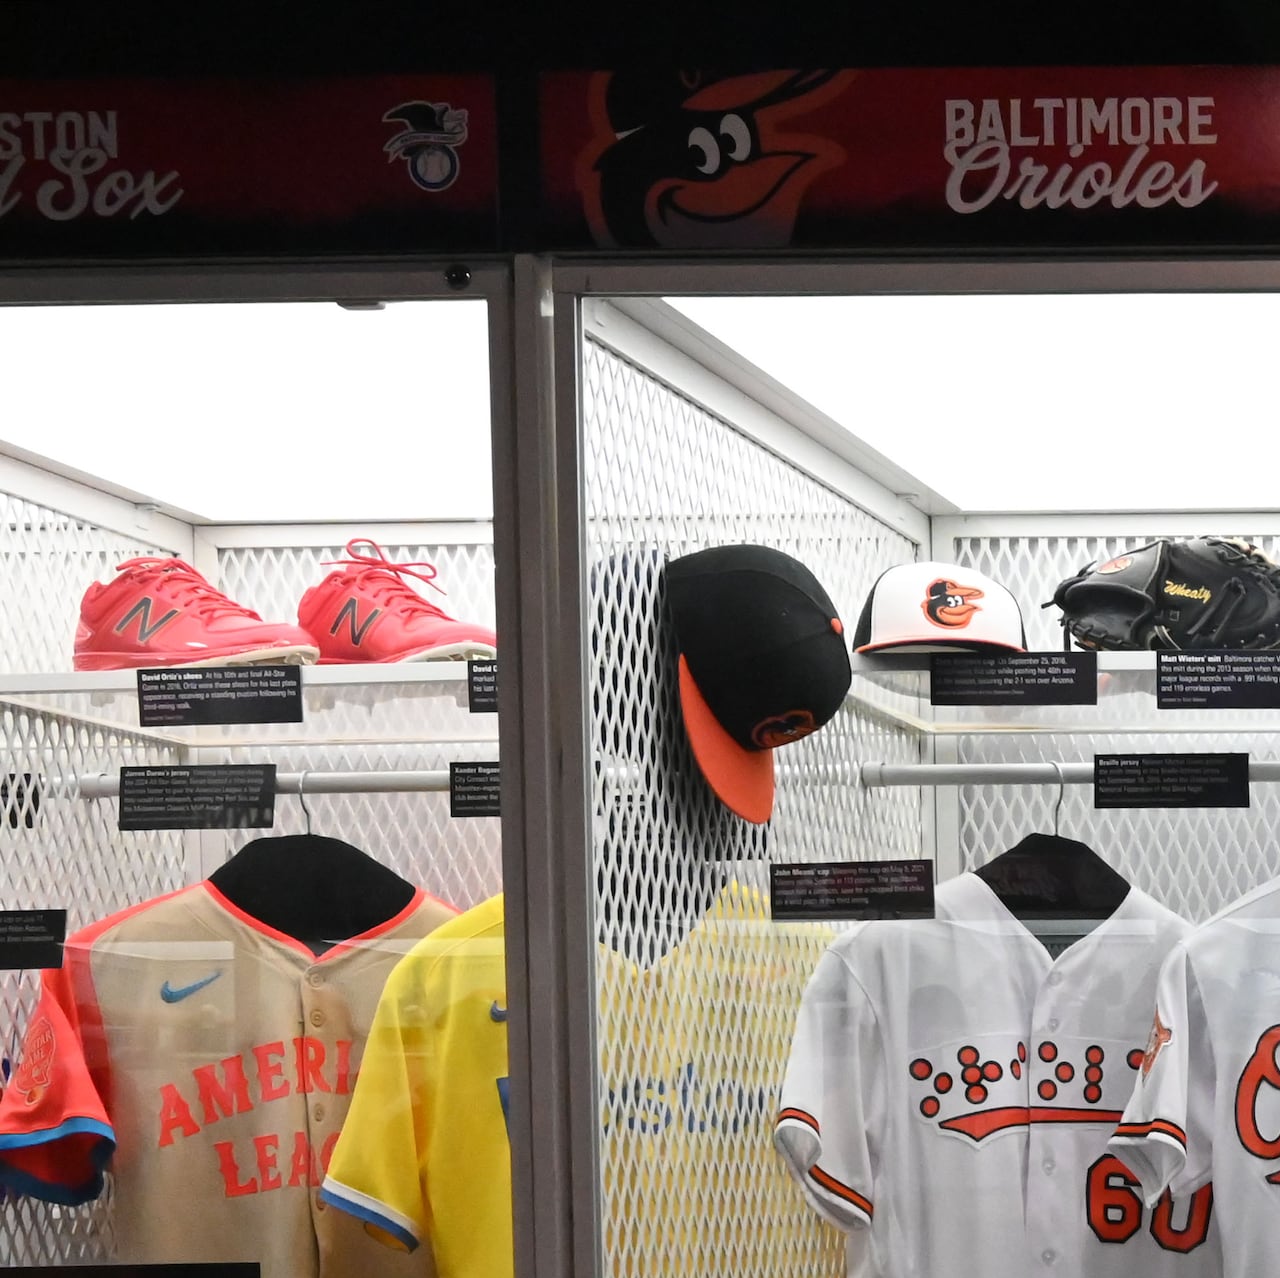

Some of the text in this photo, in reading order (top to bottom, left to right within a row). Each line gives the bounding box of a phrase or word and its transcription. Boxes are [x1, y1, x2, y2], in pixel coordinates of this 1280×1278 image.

[945, 97, 1217, 146] BALTIMORE
[35, 148, 184, 220] Sox
[944, 138, 1217, 214] Orioles
[1164, 580, 1211, 604] Wheaty
[142, 672, 160, 681] David
[158, 1037, 359, 1148] AMERI
[1086, 1154, 1213, 1253] 60
